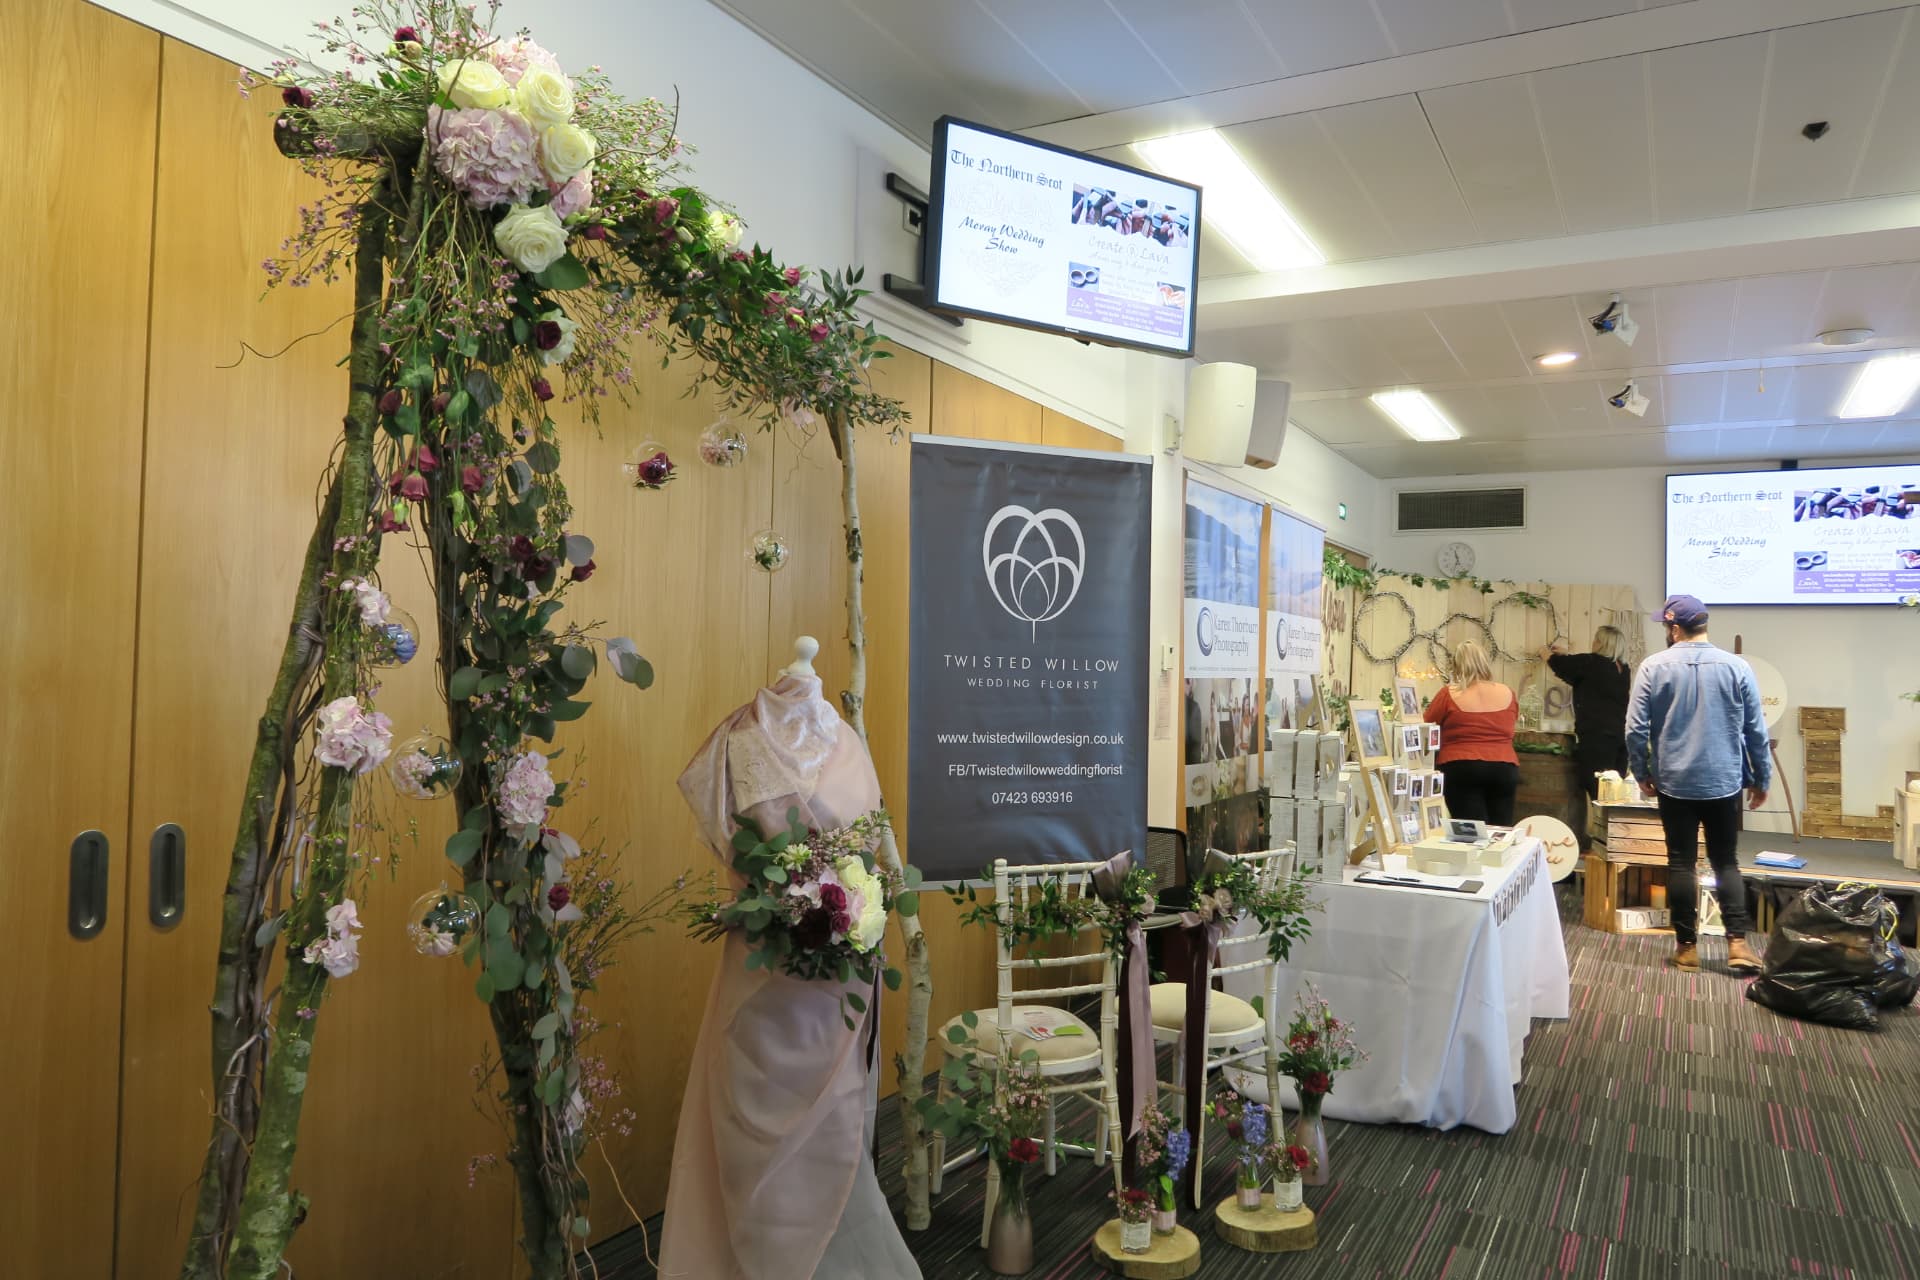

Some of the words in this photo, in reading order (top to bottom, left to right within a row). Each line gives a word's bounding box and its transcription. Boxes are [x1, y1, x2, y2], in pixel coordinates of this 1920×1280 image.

[951, 149, 975, 169] The
[978, 157, 1033, 184] Northern
[1036, 173, 1063, 191] Scot
[958, 216, 997, 237] Moray
[1000, 223, 1045, 249] Wedding
[985, 237, 1019, 255] Show
[1672, 493, 1694, 504] The
[1696, 491, 1752, 504] Northern
[1755, 490, 1783, 501] Scot
[1682, 537, 1718, 549] Moray
[1721, 536, 1767, 549] Wedding
[1708, 547, 1741, 559] Show
[943, 654, 1032, 670] TWISTED
[1044, 657, 1119, 673] WILLOW
[967, 678, 1031, 689] WEDDING
[1040, 679, 1099, 690] FLORIST
[937, 732, 1124, 747] www.twistedwillowdesign.co.uk
[948, 763, 1123, 778] FB/Twistedwillowweddingflorist
[992, 792, 1028, 804] 07423
[1031, 791, 1073, 804] 693916
[1626, 910, 1668, 930] LOVE
